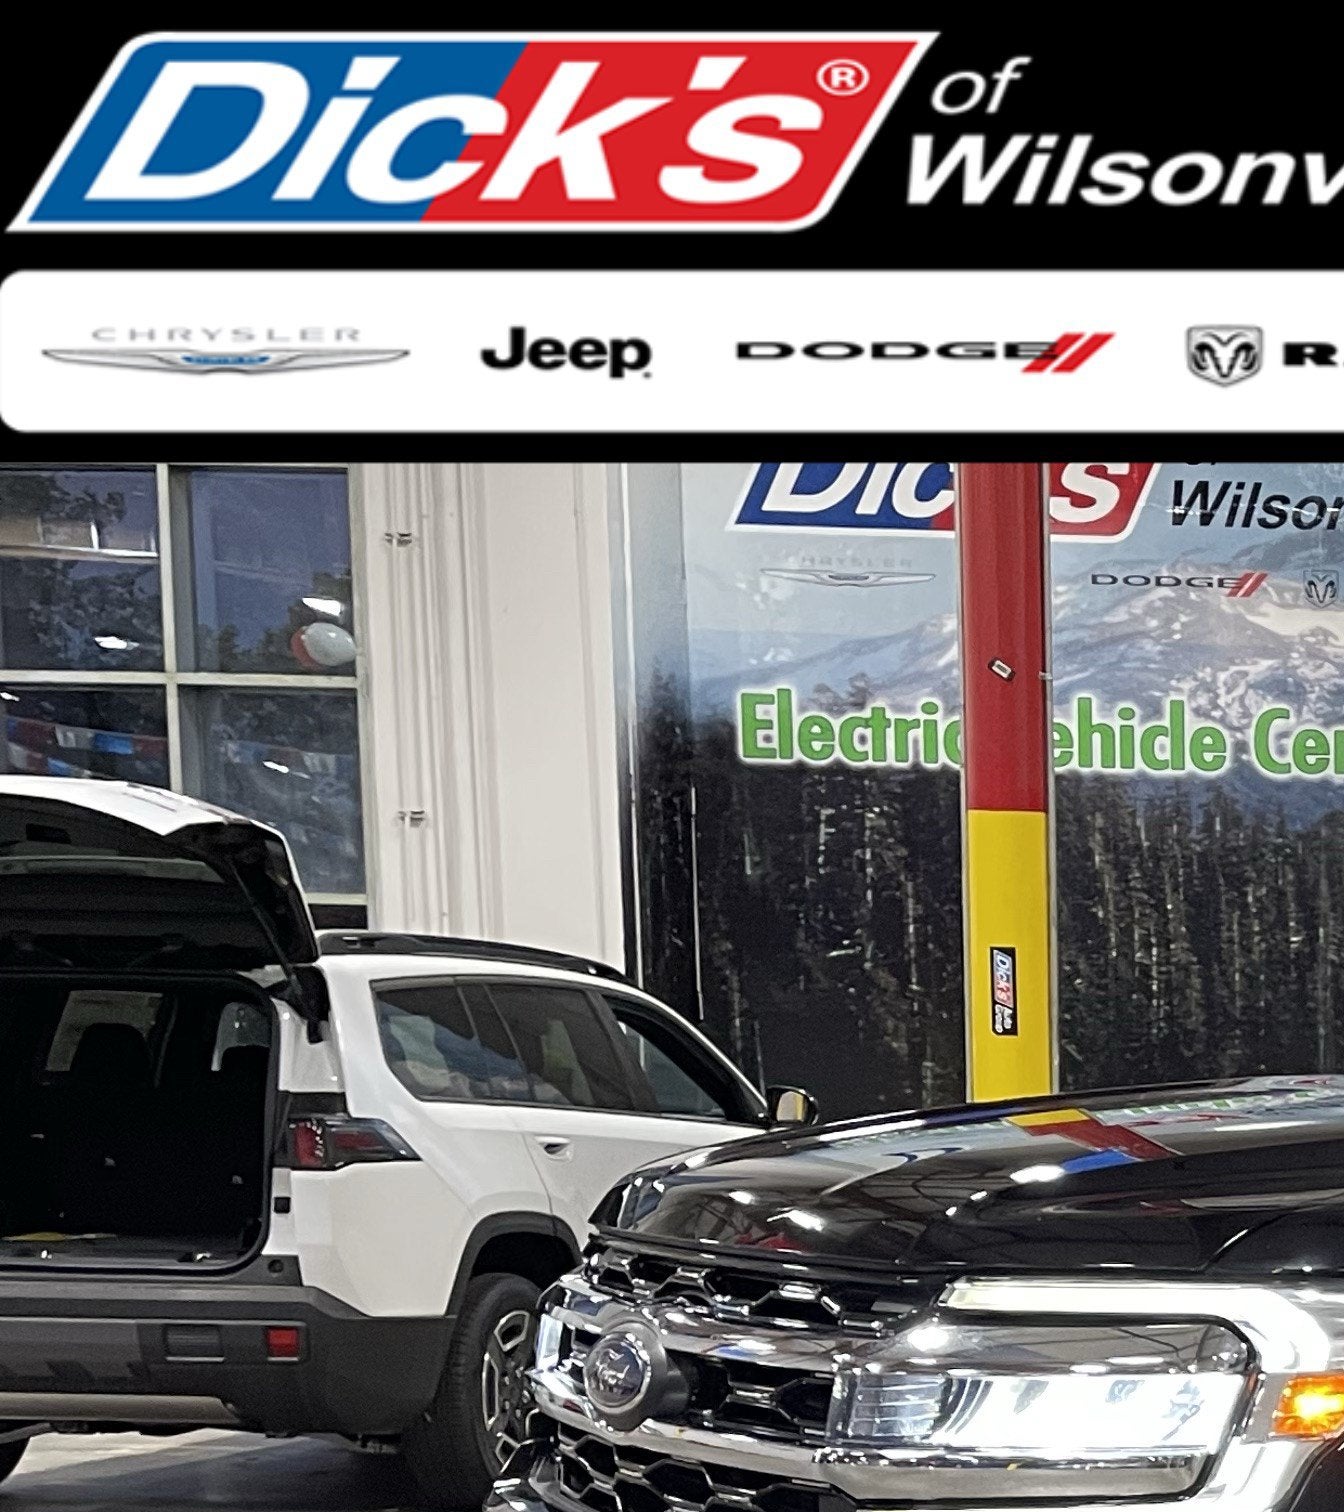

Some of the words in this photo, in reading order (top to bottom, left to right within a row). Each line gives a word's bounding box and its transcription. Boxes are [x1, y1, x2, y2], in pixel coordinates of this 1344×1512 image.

[761, 463, 1133, 523] Dics
[1091, 573, 1242, 590] DODGE
[1053, 697, 1227, 772] ehicle
